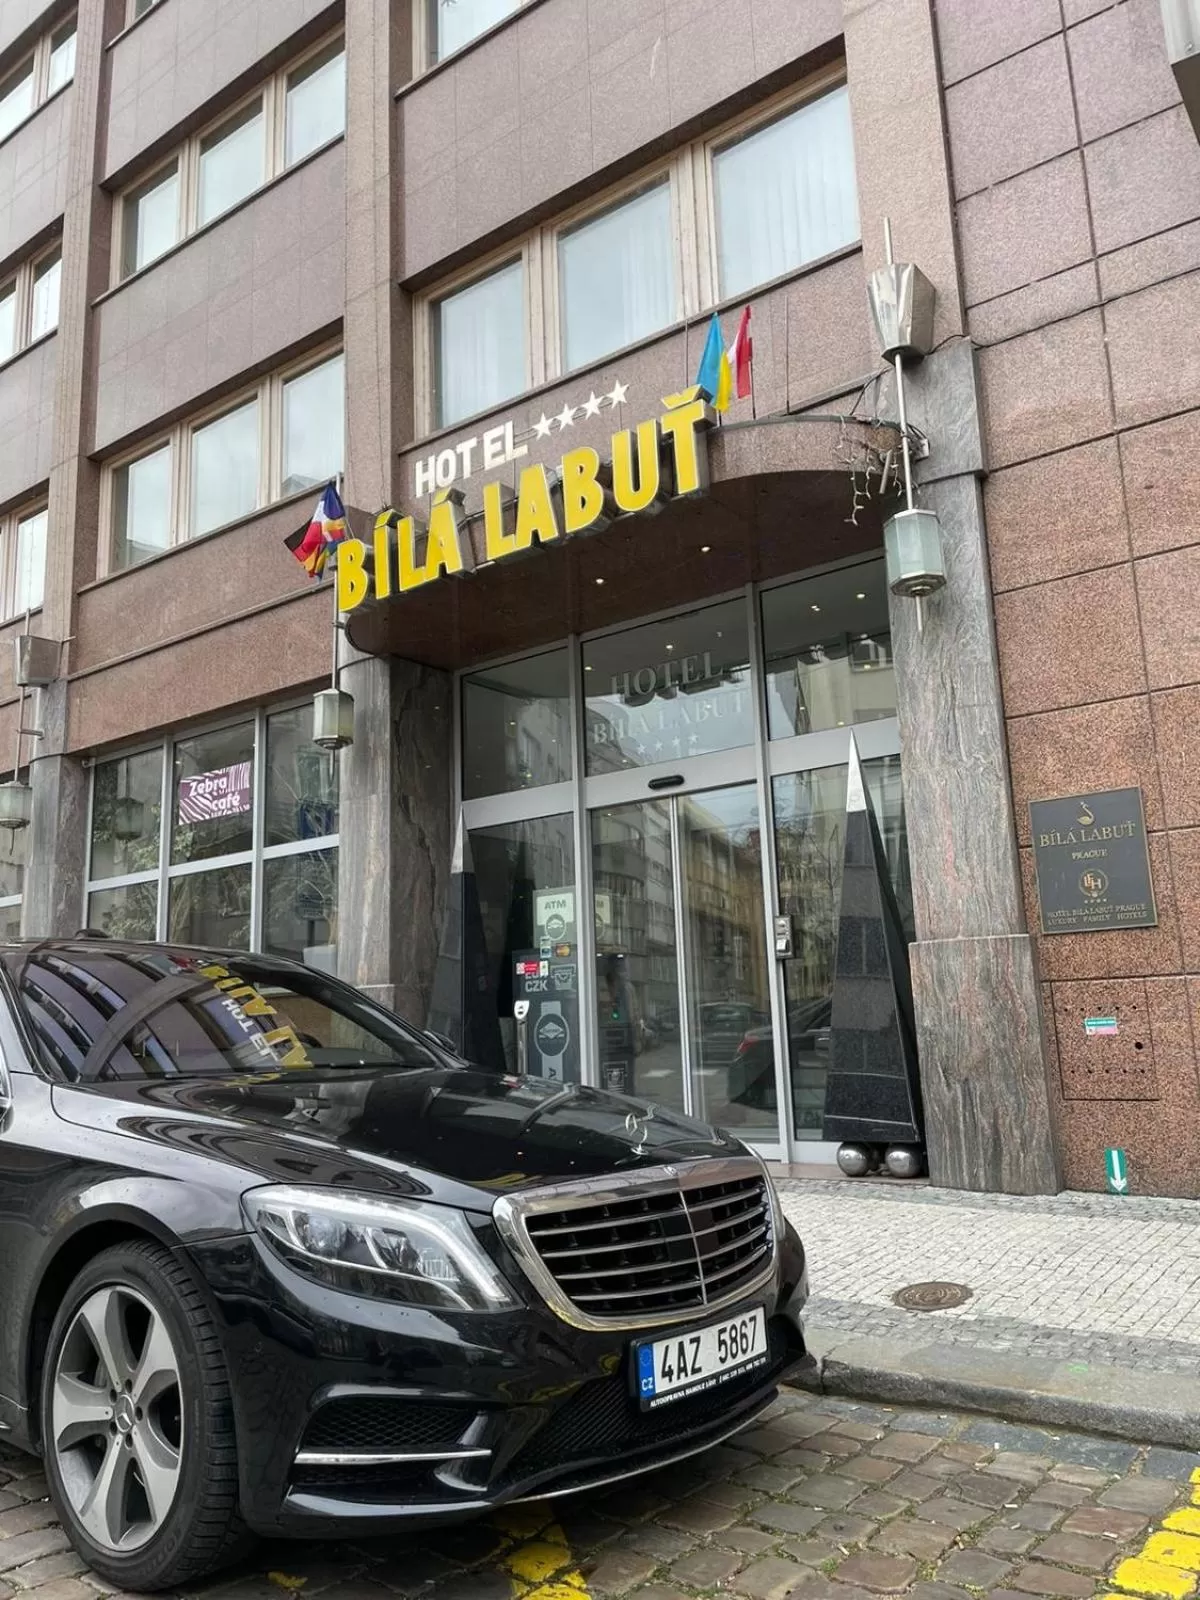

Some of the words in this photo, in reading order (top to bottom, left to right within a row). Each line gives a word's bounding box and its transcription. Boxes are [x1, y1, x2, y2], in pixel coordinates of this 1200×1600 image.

[415, 421, 528, 498] HOTEL
[337, 488, 464, 613] BÍLÁ
[483, 384, 710, 561] LABUŤ
[611, 652, 723, 695] HOTEL
[189, 777, 227, 797] Zebra
[211, 792, 240, 811] café
[1040, 828, 1077, 847] BÍLÁ
[1081, 821, 1136, 842] LABUŤ
[1072, 849, 1108, 860] PRAGUE
[544, 900, 567, 910] ATM
[1117, 910, 1148, 920] HOTELS
[525, 980, 548, 992] CZK
[661, 1335, 703, 1383] 4AZ
[718, 1314, 757, 1364] 5867
[641, 1377, 653, 1391] CZ
